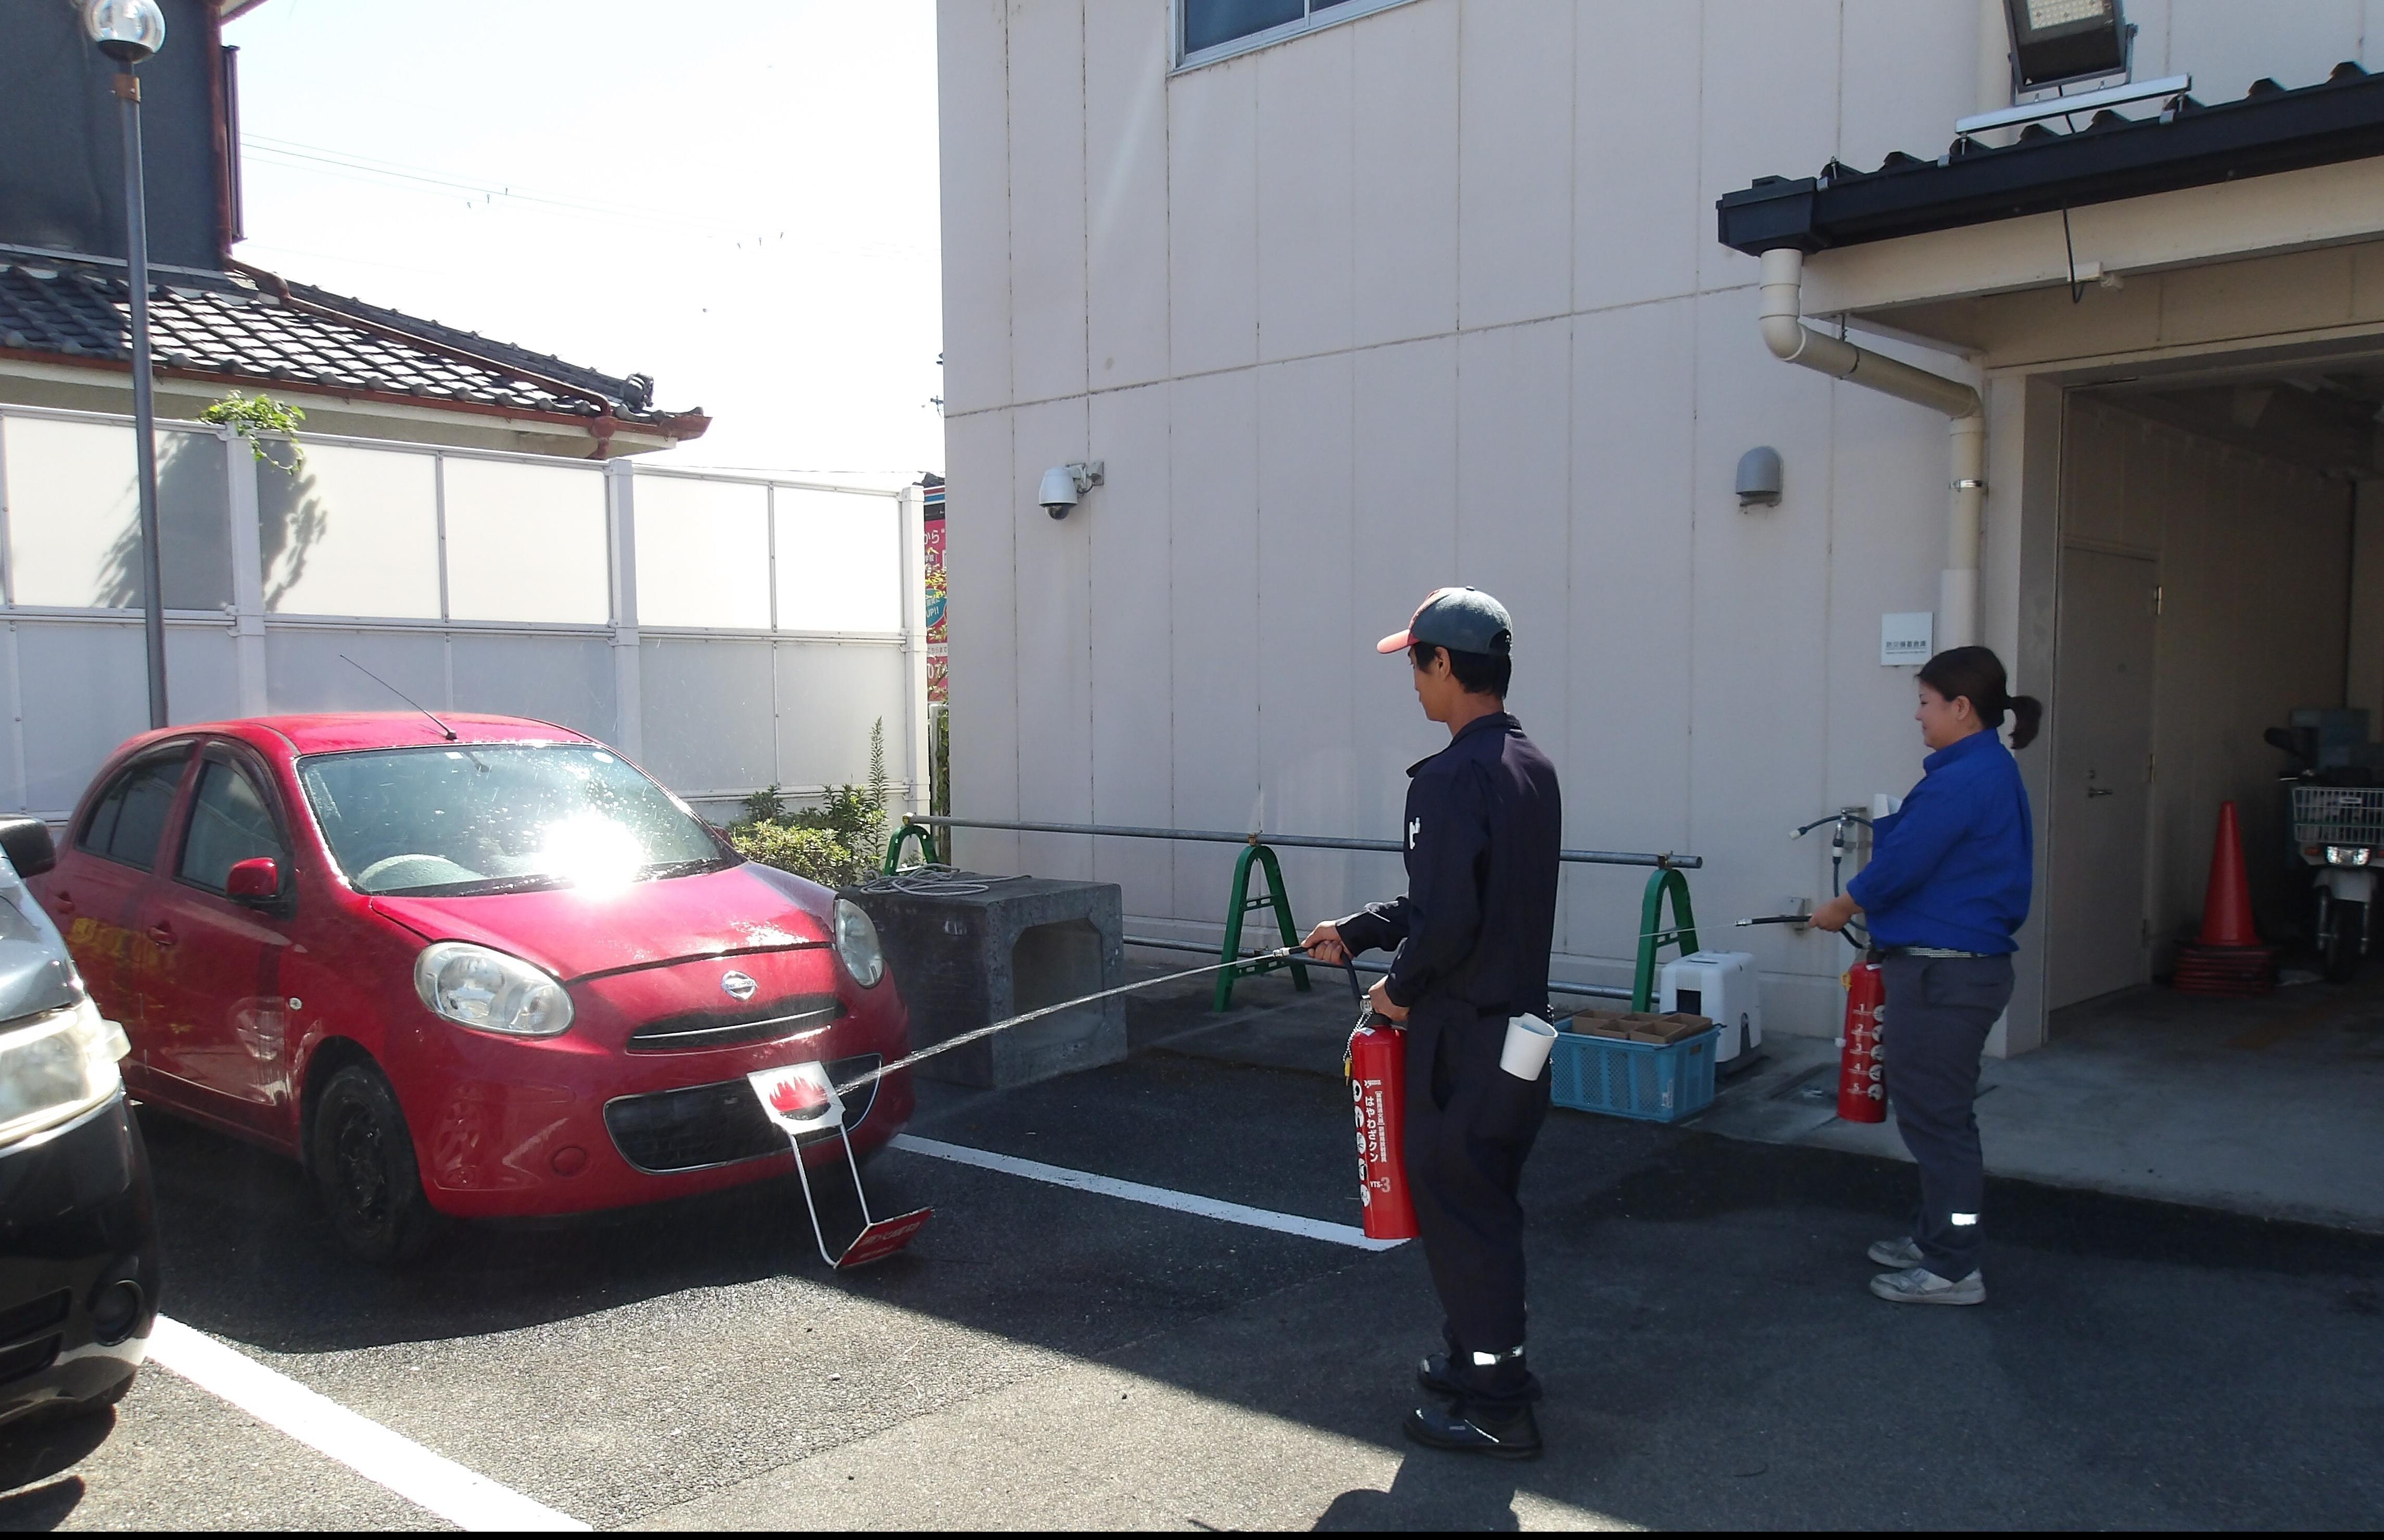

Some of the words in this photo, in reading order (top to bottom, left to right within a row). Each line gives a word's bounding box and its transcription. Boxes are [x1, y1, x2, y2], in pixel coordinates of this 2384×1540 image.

[1365, 1096, 1378, 1163] はやわざクン
[1370, 1177, 1390, 1193] YTS-3
